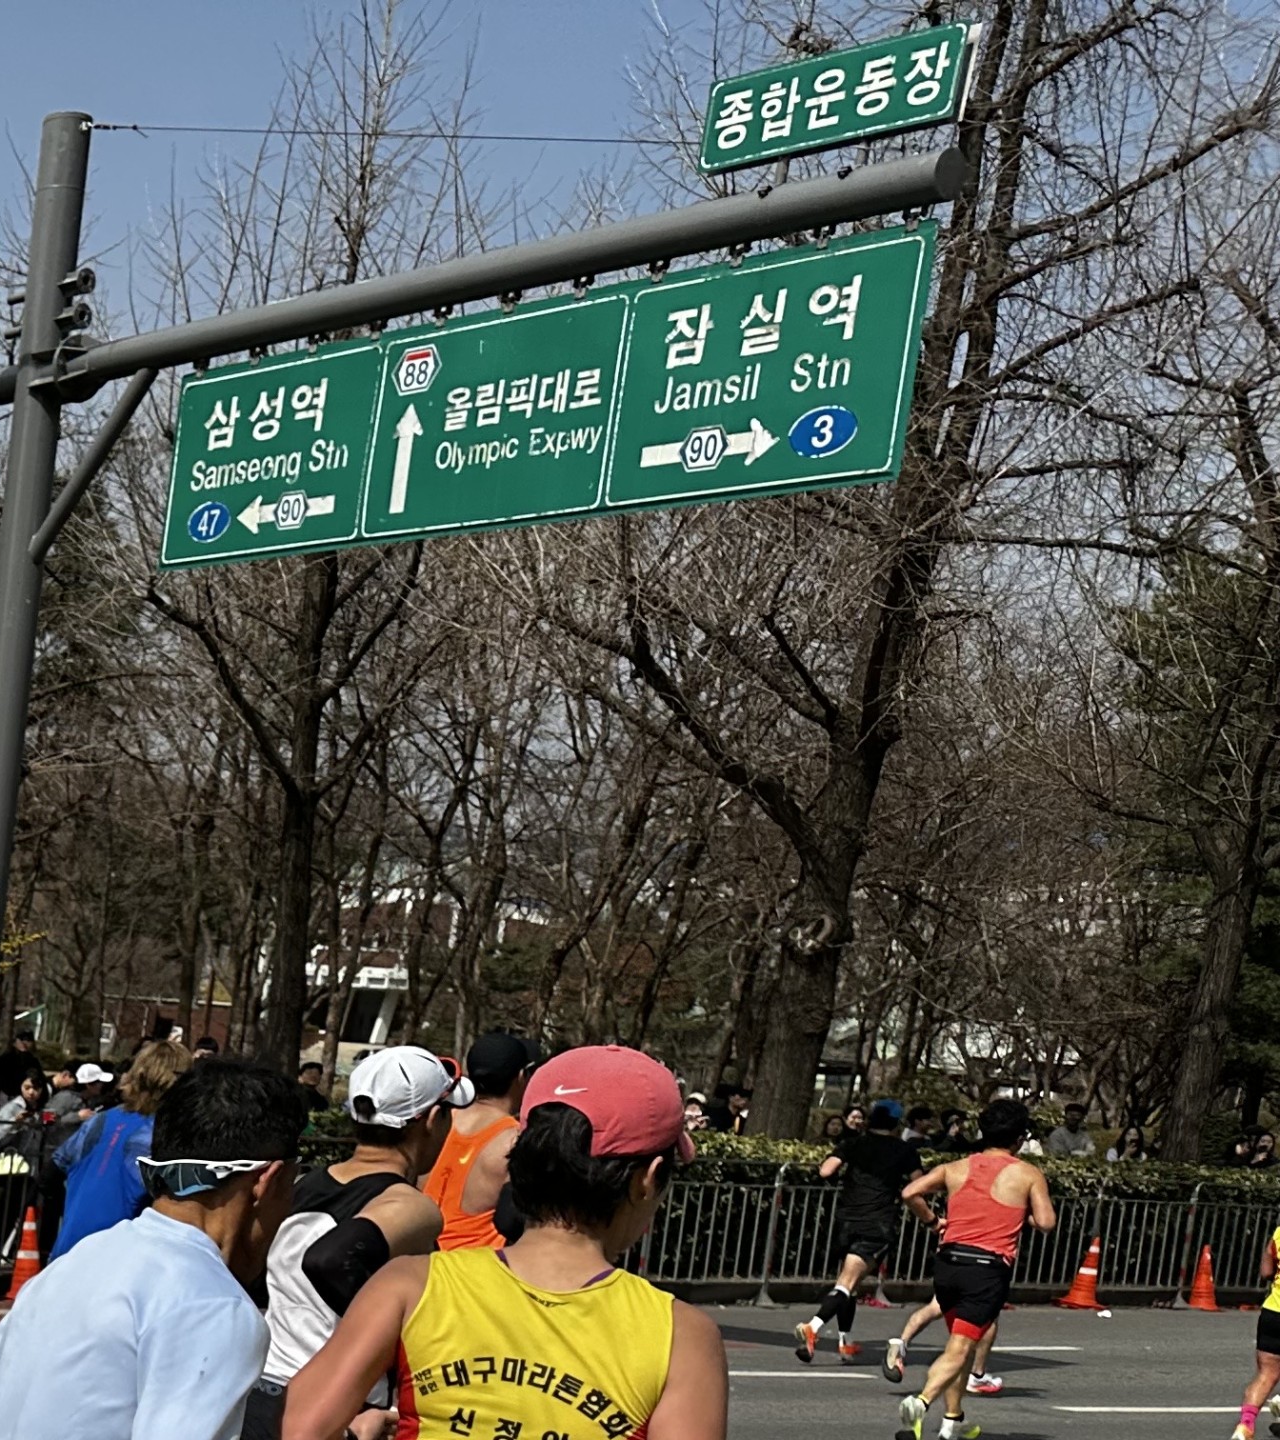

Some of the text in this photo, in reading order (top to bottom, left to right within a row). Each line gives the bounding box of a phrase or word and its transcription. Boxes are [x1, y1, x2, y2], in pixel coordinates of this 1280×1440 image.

[714, 41, 951, 150] 종합운동장
[402, 364, 429, 388] 88
[443, 367, 602, 433] 올림픽대로
[654, 352, 852, 415] Jamsil Stn
[204, 378, 329, 450] 삼성역
[810, 414, 835, 448] 3
[190, 438, 349, 494] Samseong Stn
[434, 422, 603, 473] Olympic Expwy
[689, 427, 720, 463] 90
[197, 508, 222, 537] 47
[279, 498, 305, 523] 90
[440, 1356, 634, 1440] 대구마라톤협회
